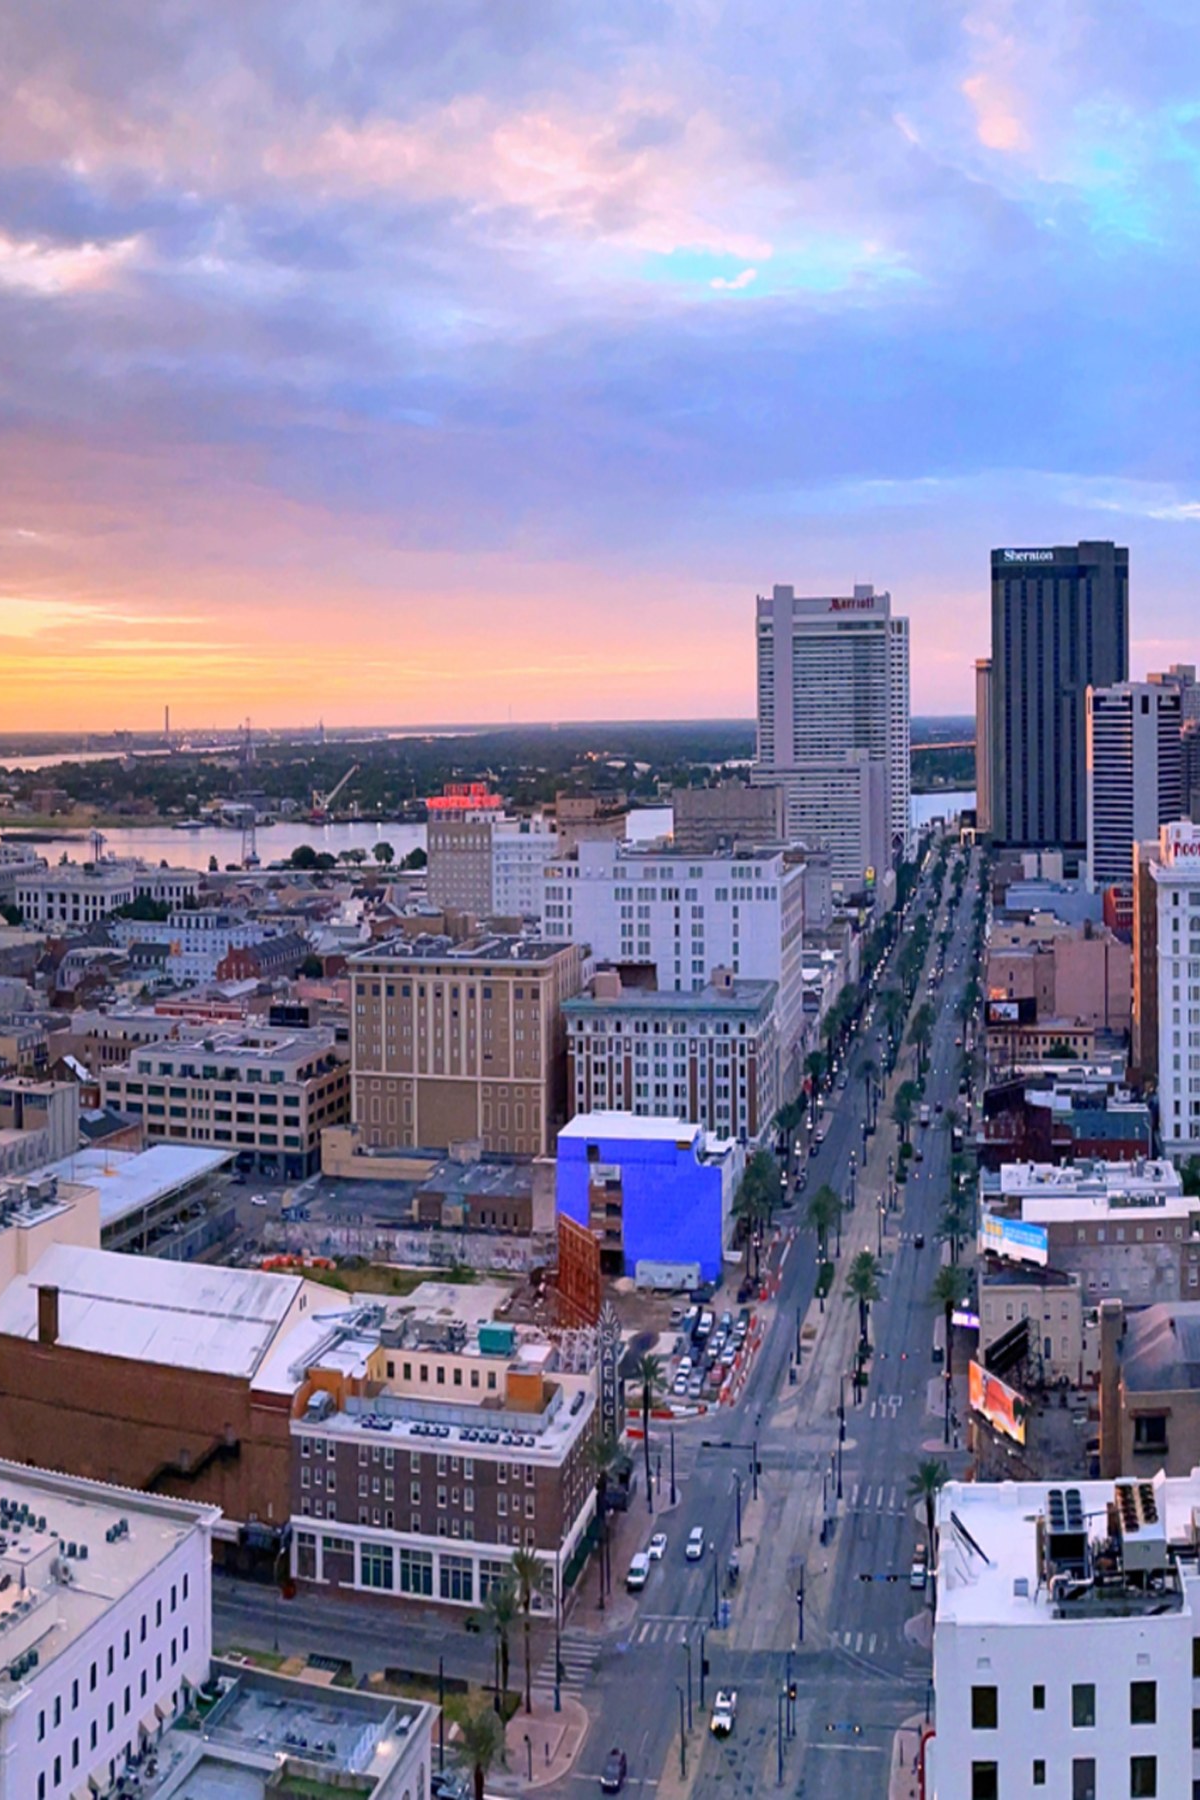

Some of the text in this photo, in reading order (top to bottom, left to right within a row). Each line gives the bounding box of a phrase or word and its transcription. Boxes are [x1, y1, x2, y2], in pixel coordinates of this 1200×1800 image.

[1003, 549, 1053, 562] Sheraton
[828, 597, 874, 611] Marriott
[603, 1328, 615, 1441] SAENGE
